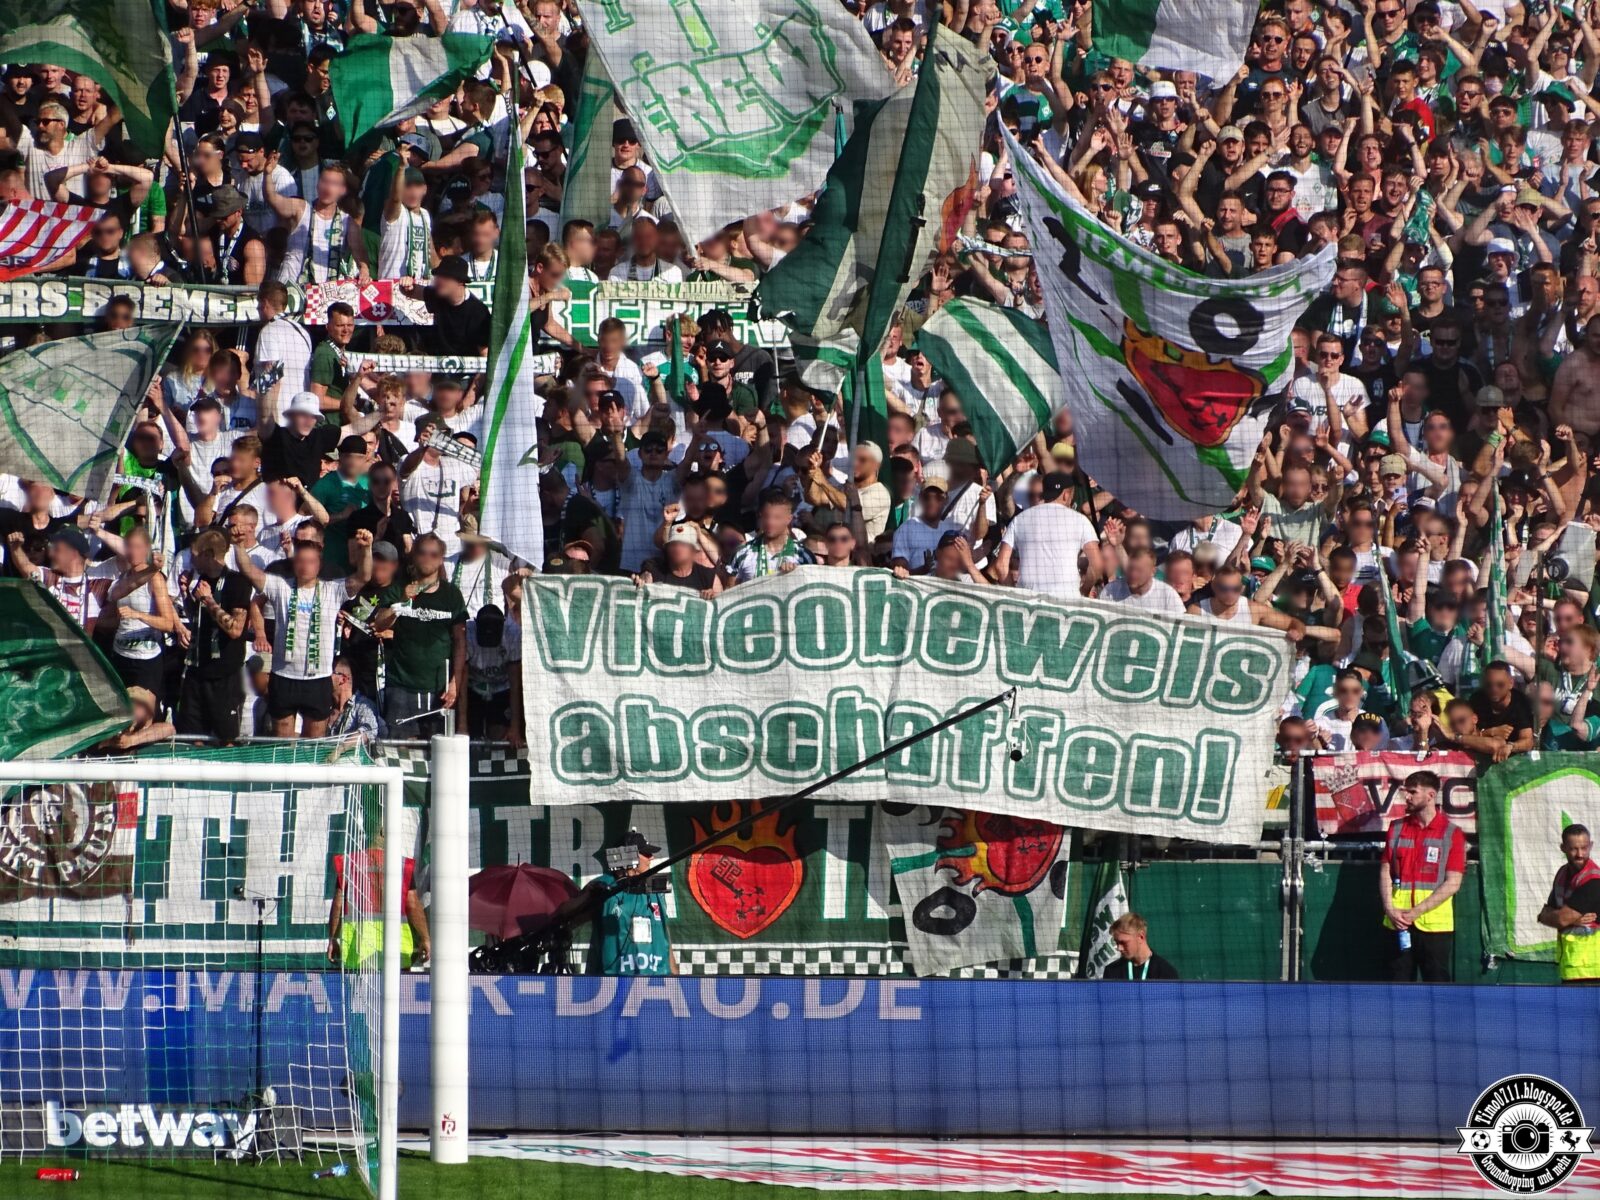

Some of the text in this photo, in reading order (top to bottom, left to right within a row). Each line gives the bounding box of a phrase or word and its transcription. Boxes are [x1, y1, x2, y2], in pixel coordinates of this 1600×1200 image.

[525, 568, 1283, 715] Videobeweis
[549, 685, 1241, 827] abschaffen!
[46, 1101, 257, 1160] betway
